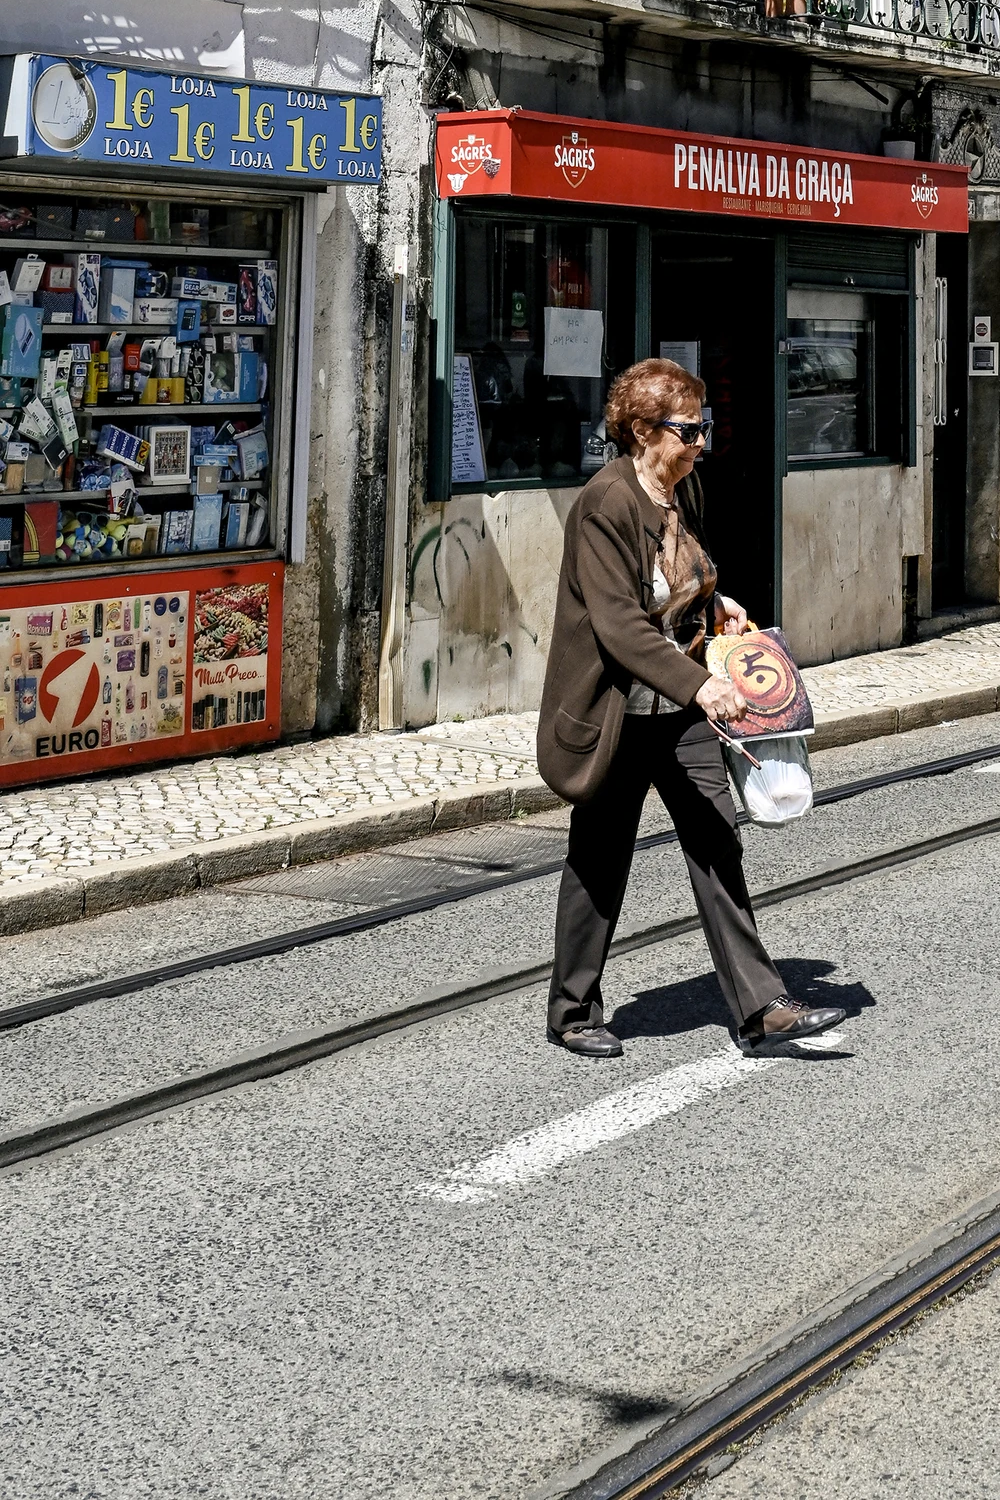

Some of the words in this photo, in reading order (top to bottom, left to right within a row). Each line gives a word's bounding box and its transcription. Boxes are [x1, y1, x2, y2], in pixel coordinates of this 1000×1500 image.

[170, 76, 217, 98] LOJA
[105, 69, 154, 131] 1€
[287, 90, 328, 110] LOJA
[231, 85, 275, 143] 1€
[339, 97, 378, 152] 1€
[169, 103, 215, 162] 1€
[286, 116, 327, 173] 1€
[104, 137, 153, 159] LOJA
[230, 150, 274, 169] LOJA
[451, 144, 492, 162] SAGRES
[554, 144, 595, 170] SAGRES
[337, 160, 376, 178] LOJA
[674, 143, 761, 197] PENALVA
[766, 155, 790, 200] DA
[795, 158, 854, 218] GRAÇA
[722, 197, 752, 211] RESTAURANTE
[911, 184, 939, 205] SAGRES
[36, 729, 99, 758] EURO
